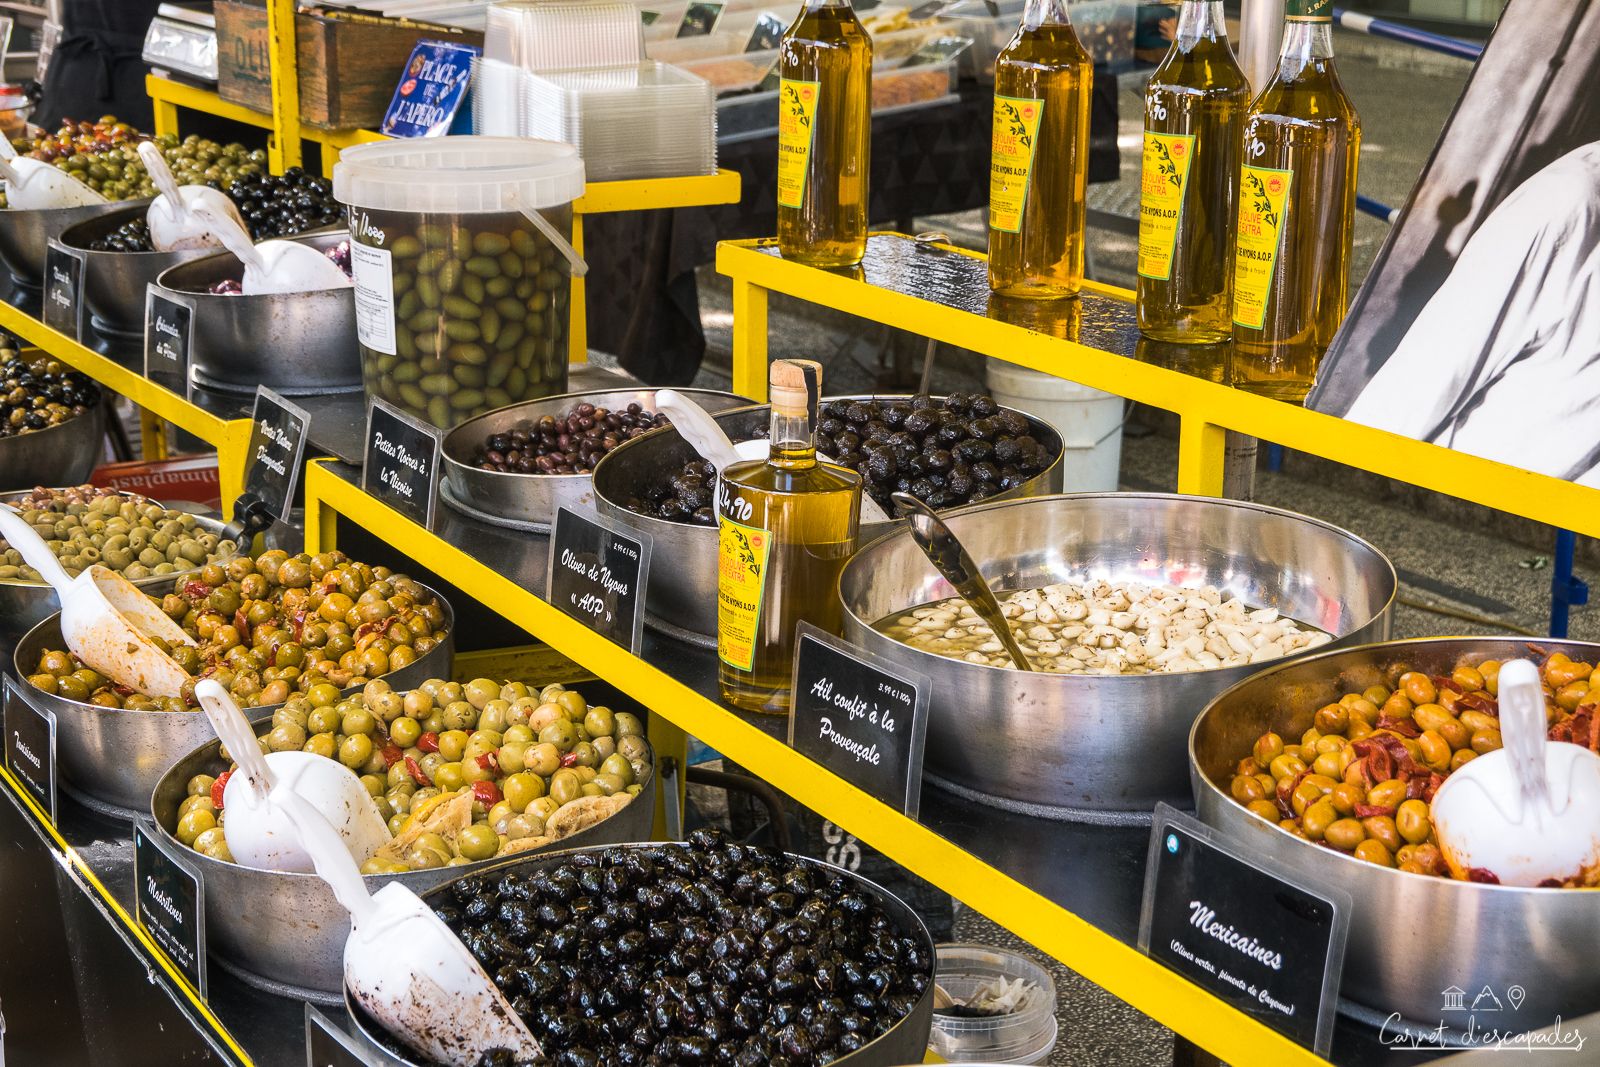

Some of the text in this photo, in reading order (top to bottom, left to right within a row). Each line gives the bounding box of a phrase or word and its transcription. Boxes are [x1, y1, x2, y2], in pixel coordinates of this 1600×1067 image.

[419, 60, 458, 84] PLACE
[1148, 184, 1166, 196] EXTRA
[1162, 210, 1177, 219] A.O.P.
[1242, 225, 1262, 236] EXTRA
[1257, 251, 1272, 262] A.O.P.
[374, 432, 426, 474] Petites Noires à
[380, 466, 412, 497] la Niçoise
[561, 548, 628, 596] Olives de Nyons
[578, 593, 604, 616] AOP
[730, 598, 742, 610] NYONS
[743, 602, 756, 612] A.O.P.
[810, 678, 895, 732] Ail confit à la
[820, 716, 880, 766] Provençale
[1190, 900, 1282, 970] Mexicaines
[1170, 939, 1194, 962] (Olives
[1218, 970, 1246, 991] piments
[1248, 984, 1257, 998] de
[1258, 990, 1295, 1016] Cayenne)
